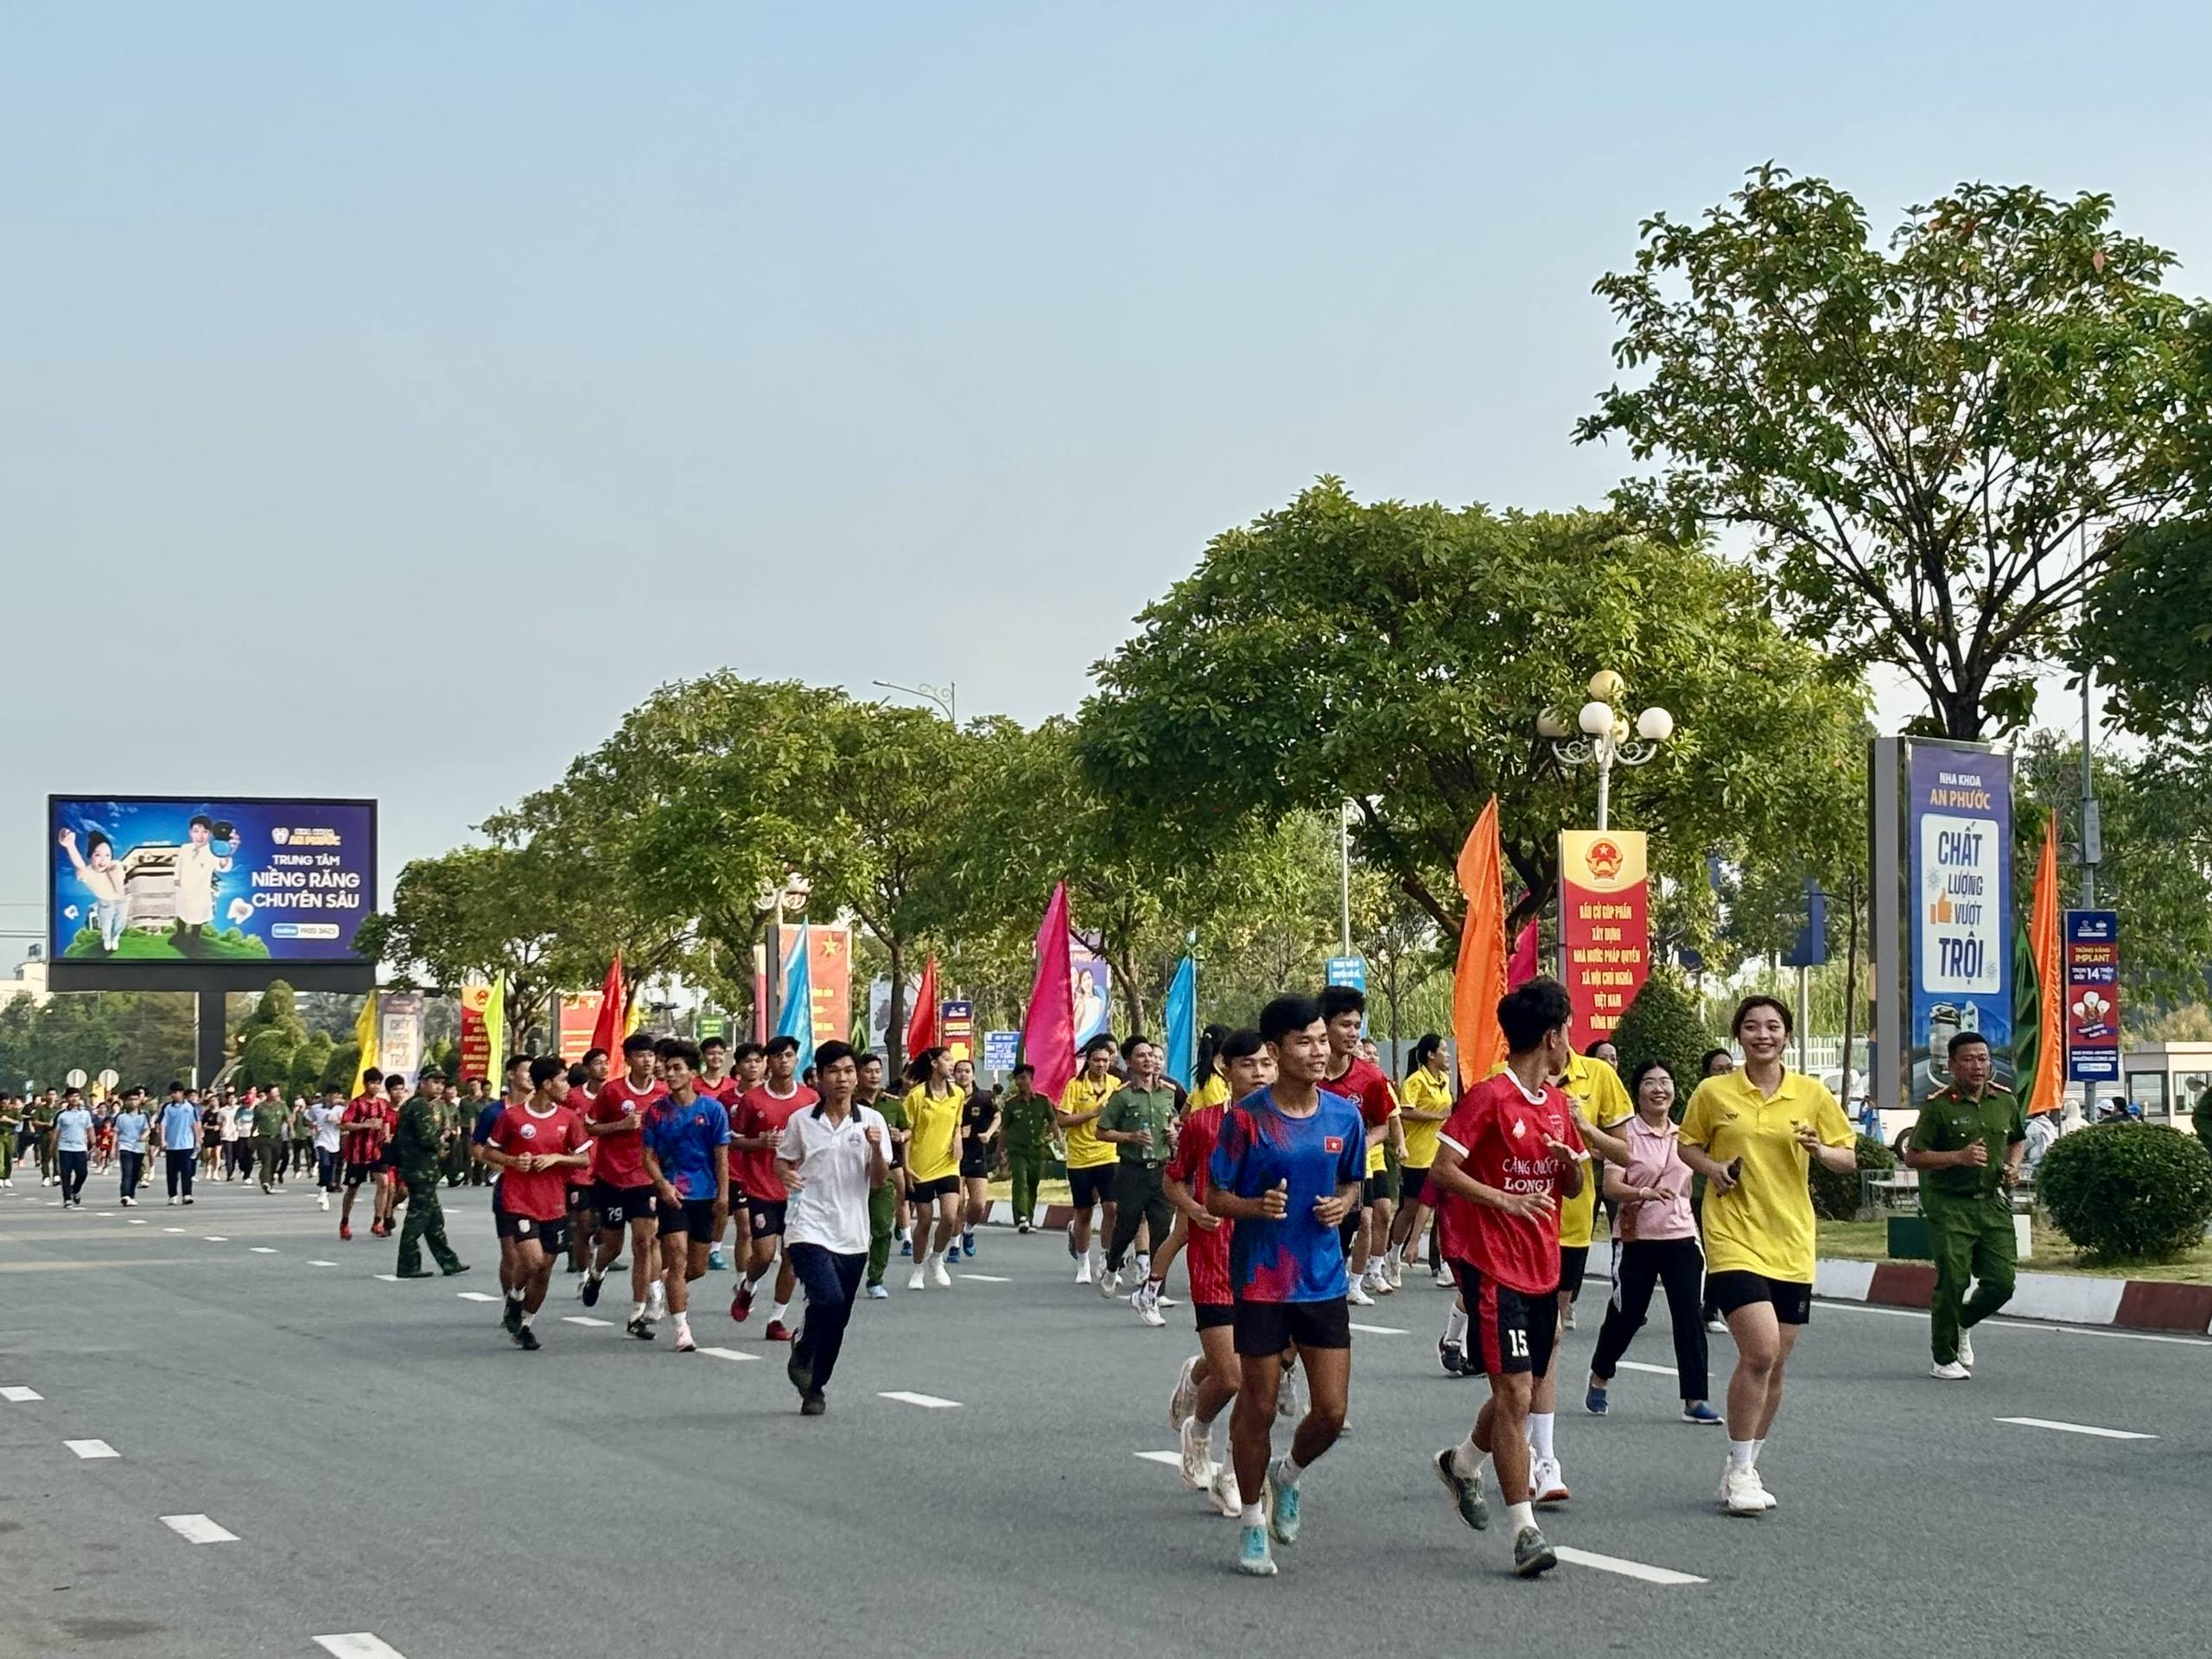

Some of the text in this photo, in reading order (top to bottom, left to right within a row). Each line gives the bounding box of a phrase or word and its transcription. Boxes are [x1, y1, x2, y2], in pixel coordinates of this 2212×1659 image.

[1939, 772, 1981, 787] NHA KHOA
[1929, 788, 1991, 810] AN PHƯỚC
[1938, 821, 1983, 867] CHẤT
[271, 853, 340, 866] TRUNG TÂM
[251, 865, 361, 888] NIỀNG RĂNG
[1948, 869, 1984, 899] LƯỢNG
[251, 889, 360, 908] CHUYÊN SÂU
[1938, 931, 1984, 985] TRỘI
[2075, 953, 2110, 963] IMPLANT
[2087, 967, 2100, 980] 14
[1504, 1177, 1544, 1193] LONG
[607, 1207, 623, 1222] 79
[1508, 1329, 1529, 1357] 15
